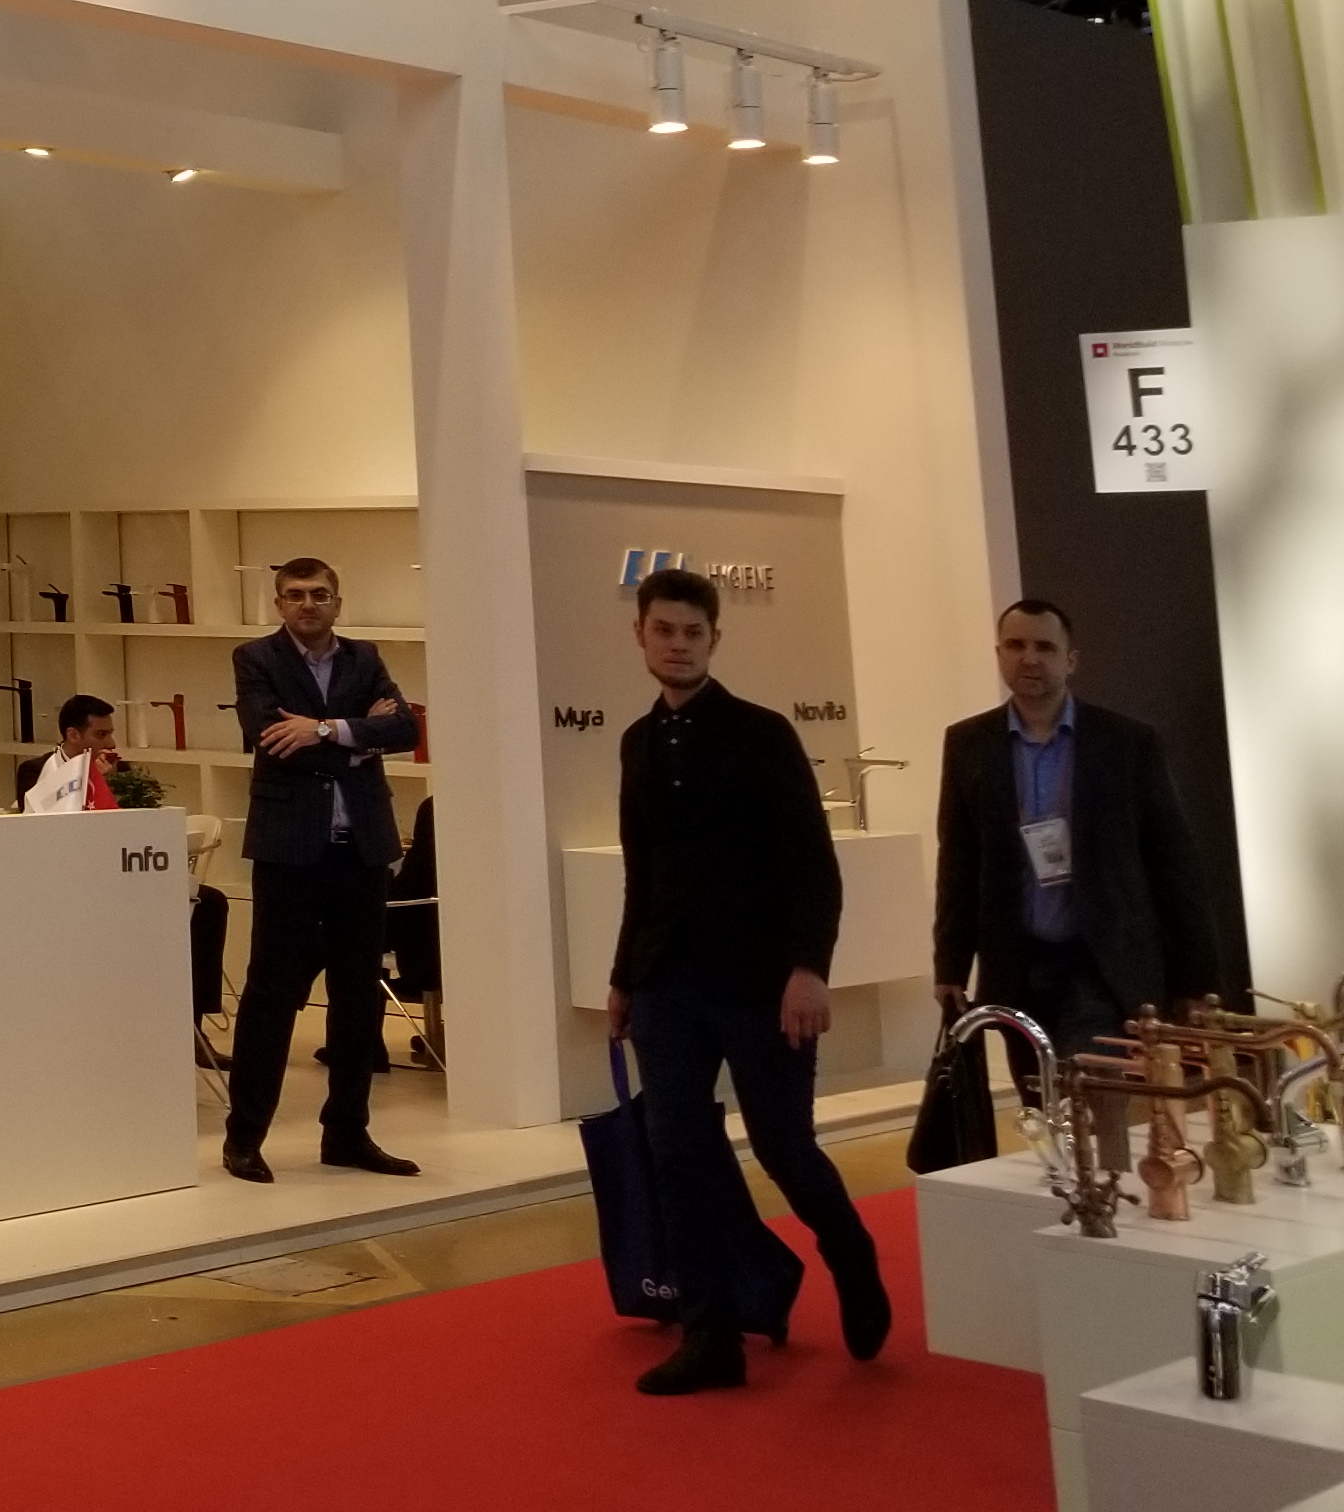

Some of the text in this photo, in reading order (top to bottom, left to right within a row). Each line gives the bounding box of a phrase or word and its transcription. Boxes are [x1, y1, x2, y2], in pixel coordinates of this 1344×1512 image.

[1127, 366, 1165, 418] F
[1112, 423, 1193, 456] 433
[554, 705, 604, 731] Myra
[793, 701, 847, 721] Novita
[121, 845, 169, 873] Info
